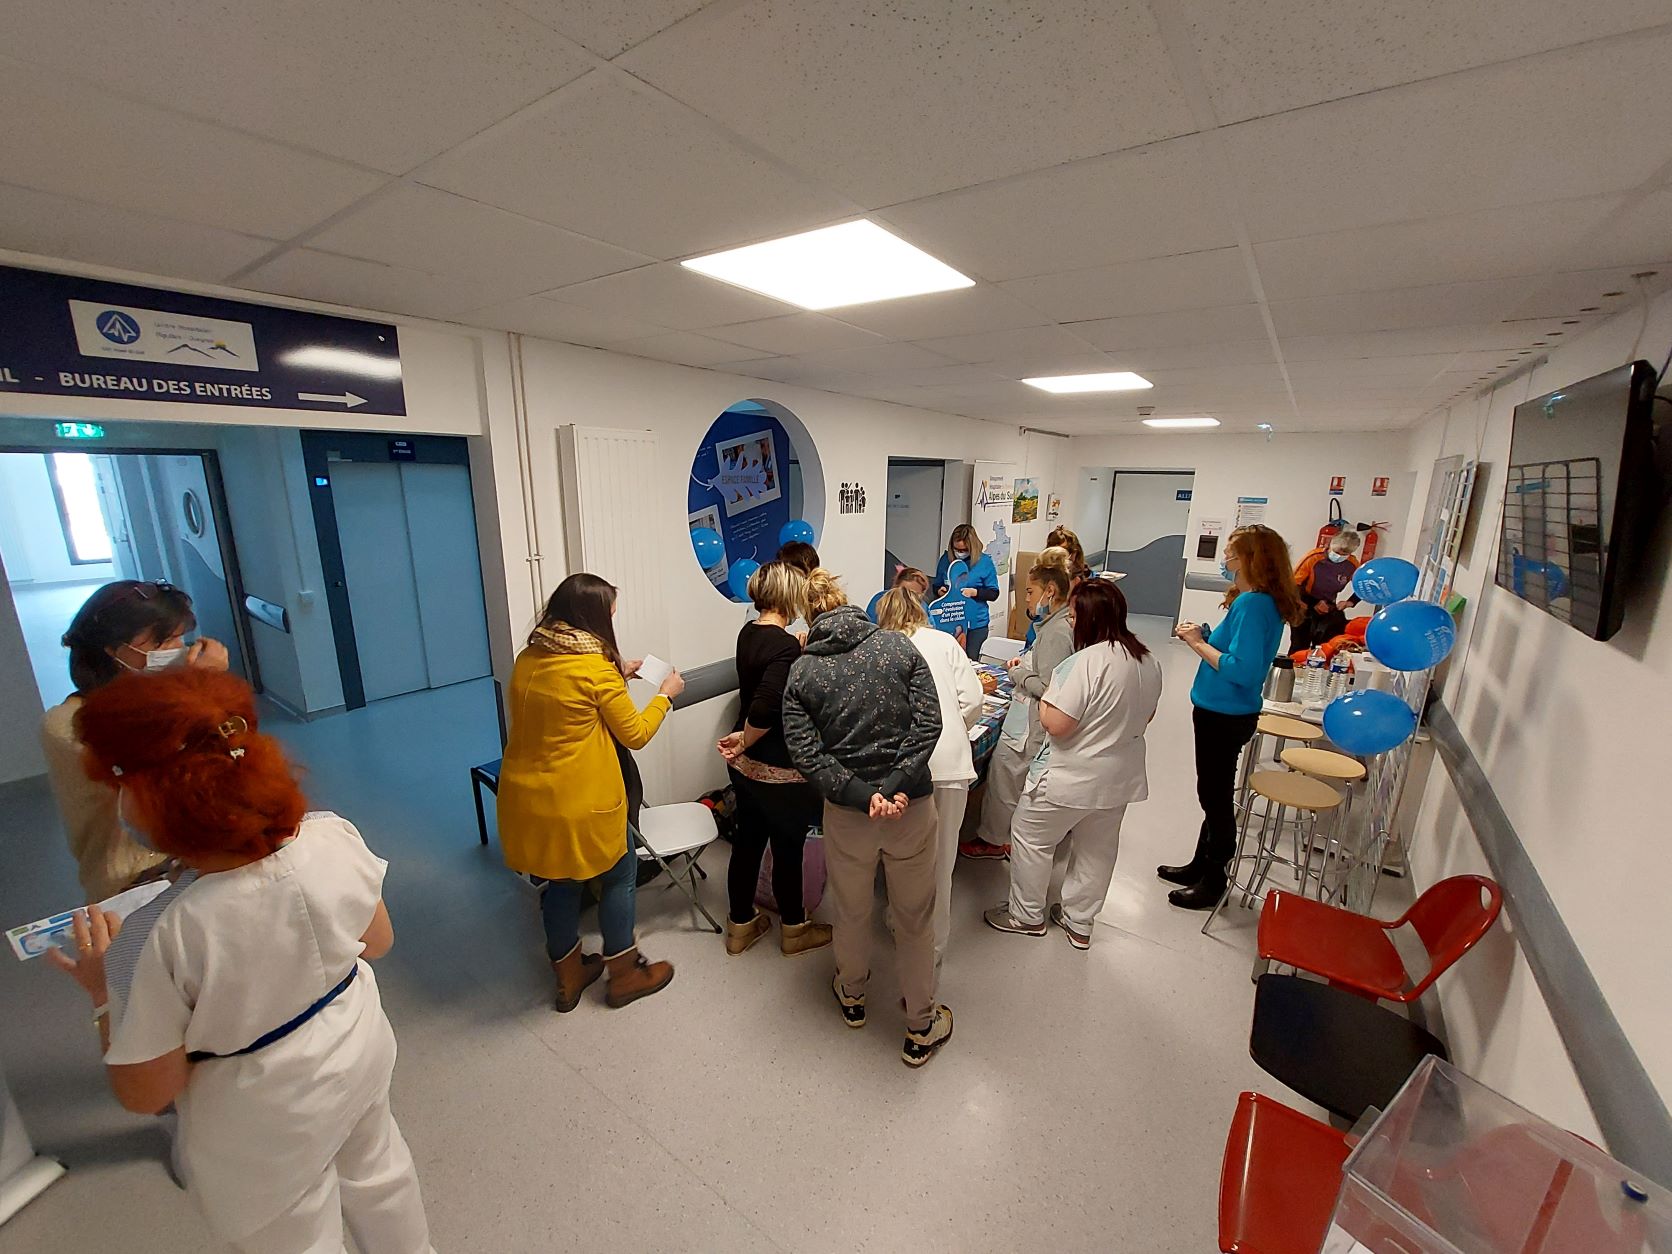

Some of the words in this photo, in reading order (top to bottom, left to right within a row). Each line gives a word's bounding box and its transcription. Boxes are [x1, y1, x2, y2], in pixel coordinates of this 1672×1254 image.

[58, 371, 148, 392] BUREAU
[152, 379, 191, 395] DES
[194, 382, 272, 400] ENTRÉES
[988, 490, 1000, 502] Alpes
